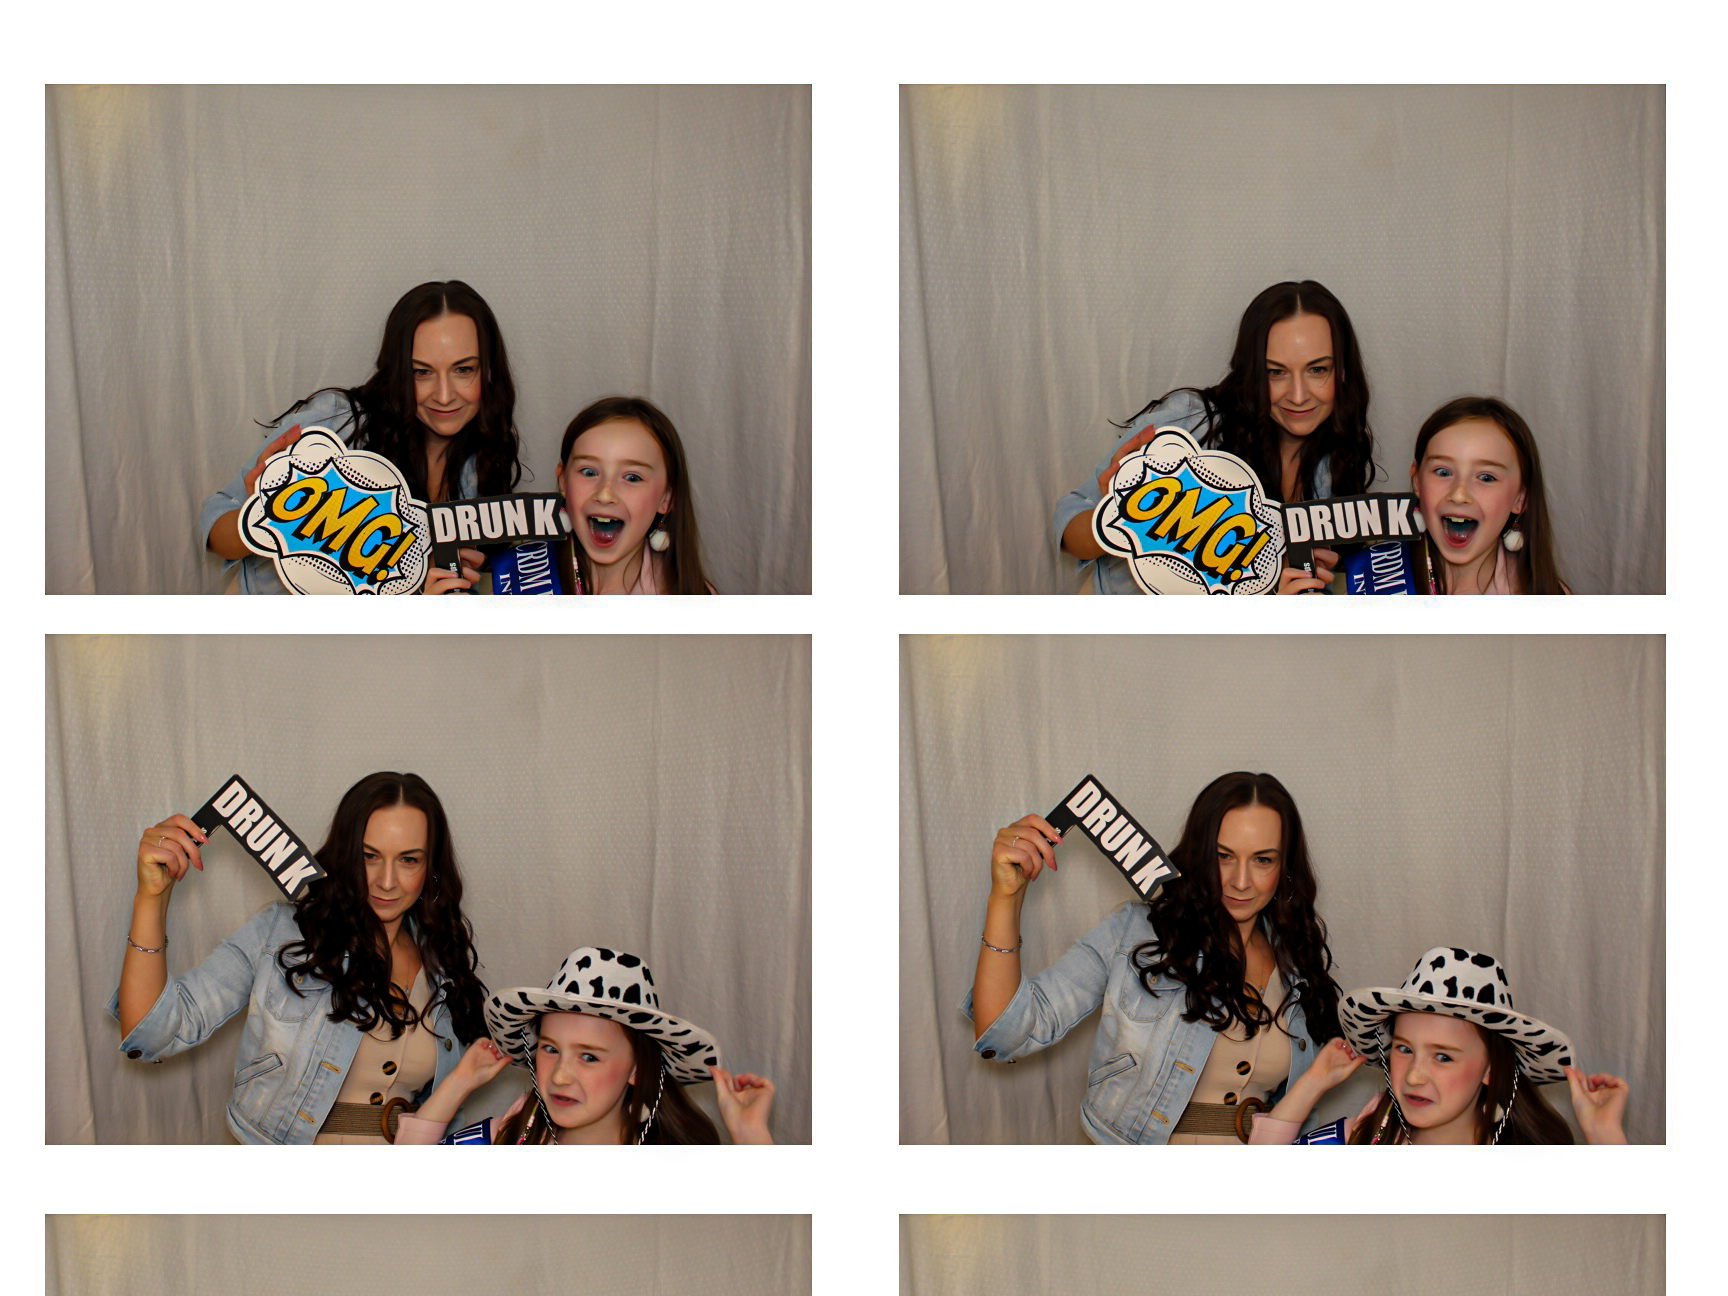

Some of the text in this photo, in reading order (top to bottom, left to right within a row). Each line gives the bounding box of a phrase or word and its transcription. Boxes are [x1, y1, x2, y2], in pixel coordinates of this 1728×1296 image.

[267, 477, 418, 583] OMG!
[431, 499, 559, 543] DRUNK
[1121, 477, 1272, 583] OMG!
[1285, 499, 1413, 543] DRUNK
[499, 572, 513, 595] IN
[1353, 572, 1367, 595] IN
[212, 780, 317, 895] DRUNK
[1066, 780, 1171, 895] DRUNK
